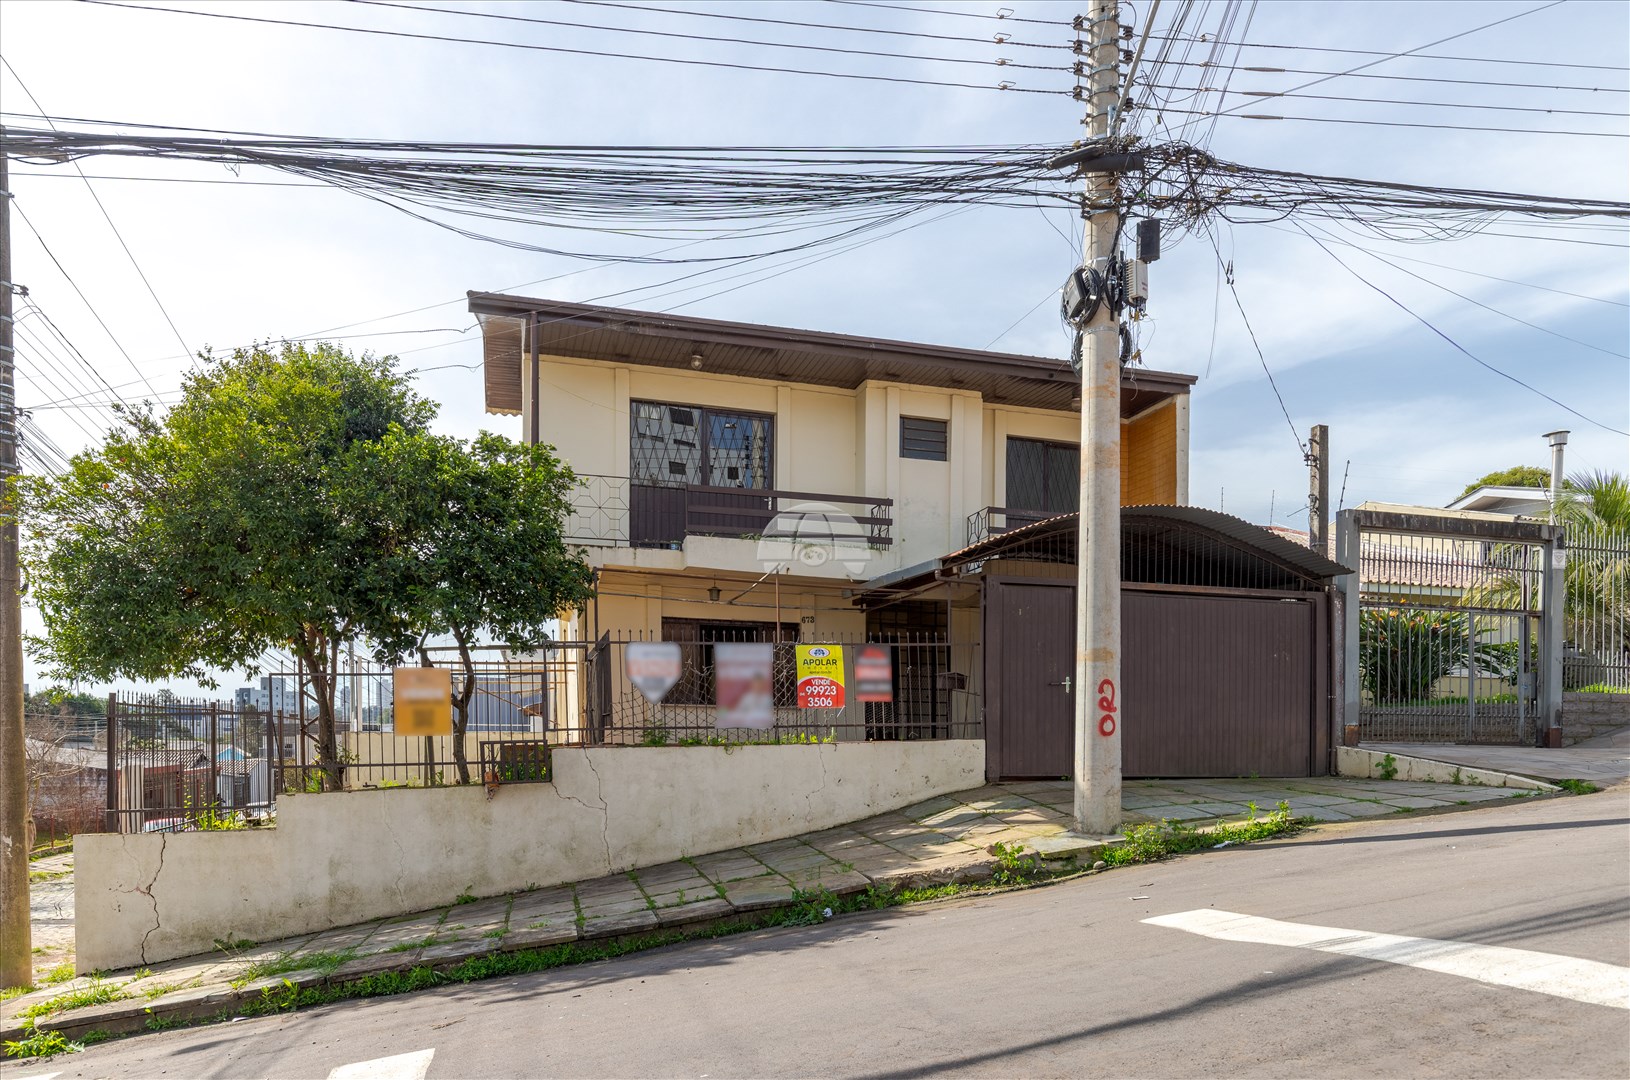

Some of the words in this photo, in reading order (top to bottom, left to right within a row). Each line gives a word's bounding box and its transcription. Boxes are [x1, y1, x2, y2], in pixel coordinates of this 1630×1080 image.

[801, 616, 815, 624] 673
[805, 685, 837, 695] 99923
[807, 697, 833, 707] 3506
